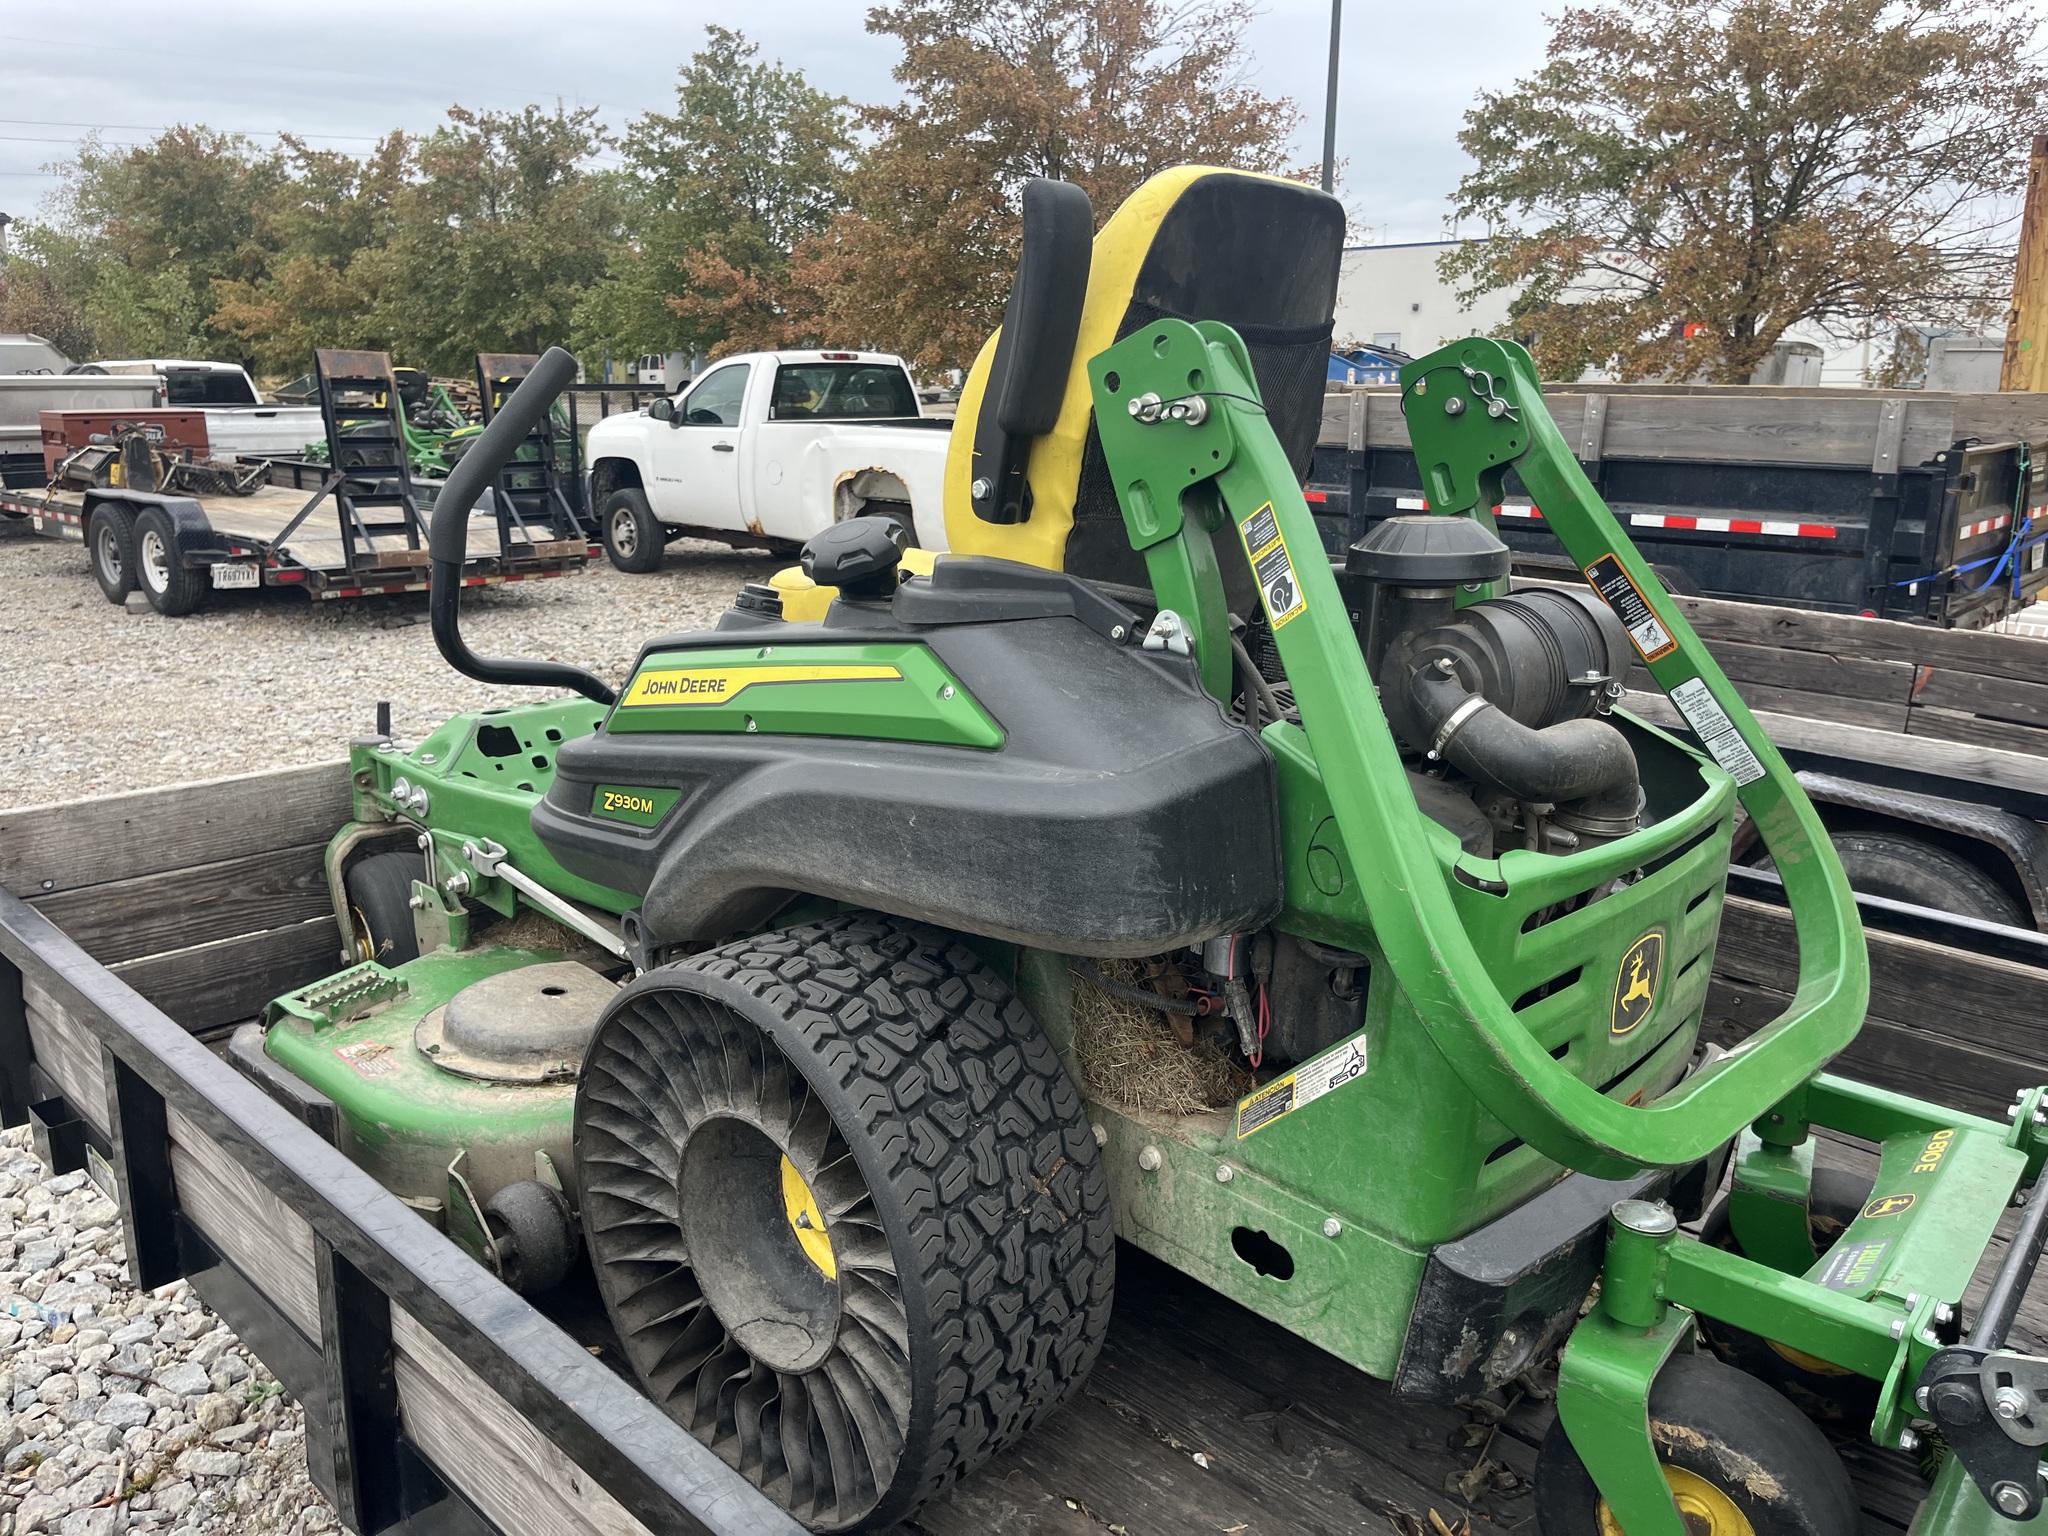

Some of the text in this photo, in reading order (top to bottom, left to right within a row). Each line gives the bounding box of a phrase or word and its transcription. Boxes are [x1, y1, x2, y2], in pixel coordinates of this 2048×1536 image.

[1275, 607, 1299, 630] CAUTION
[1646, 645, 1670, 662] WARNING
[642, 677, 727, 694] JOHN DEERE
[603, 791, 653, 814] Z930M
[1255, 1080, 1284, 1101] ATENCIÓN
[1843, 1243, 1885, 1283] TRULAND
